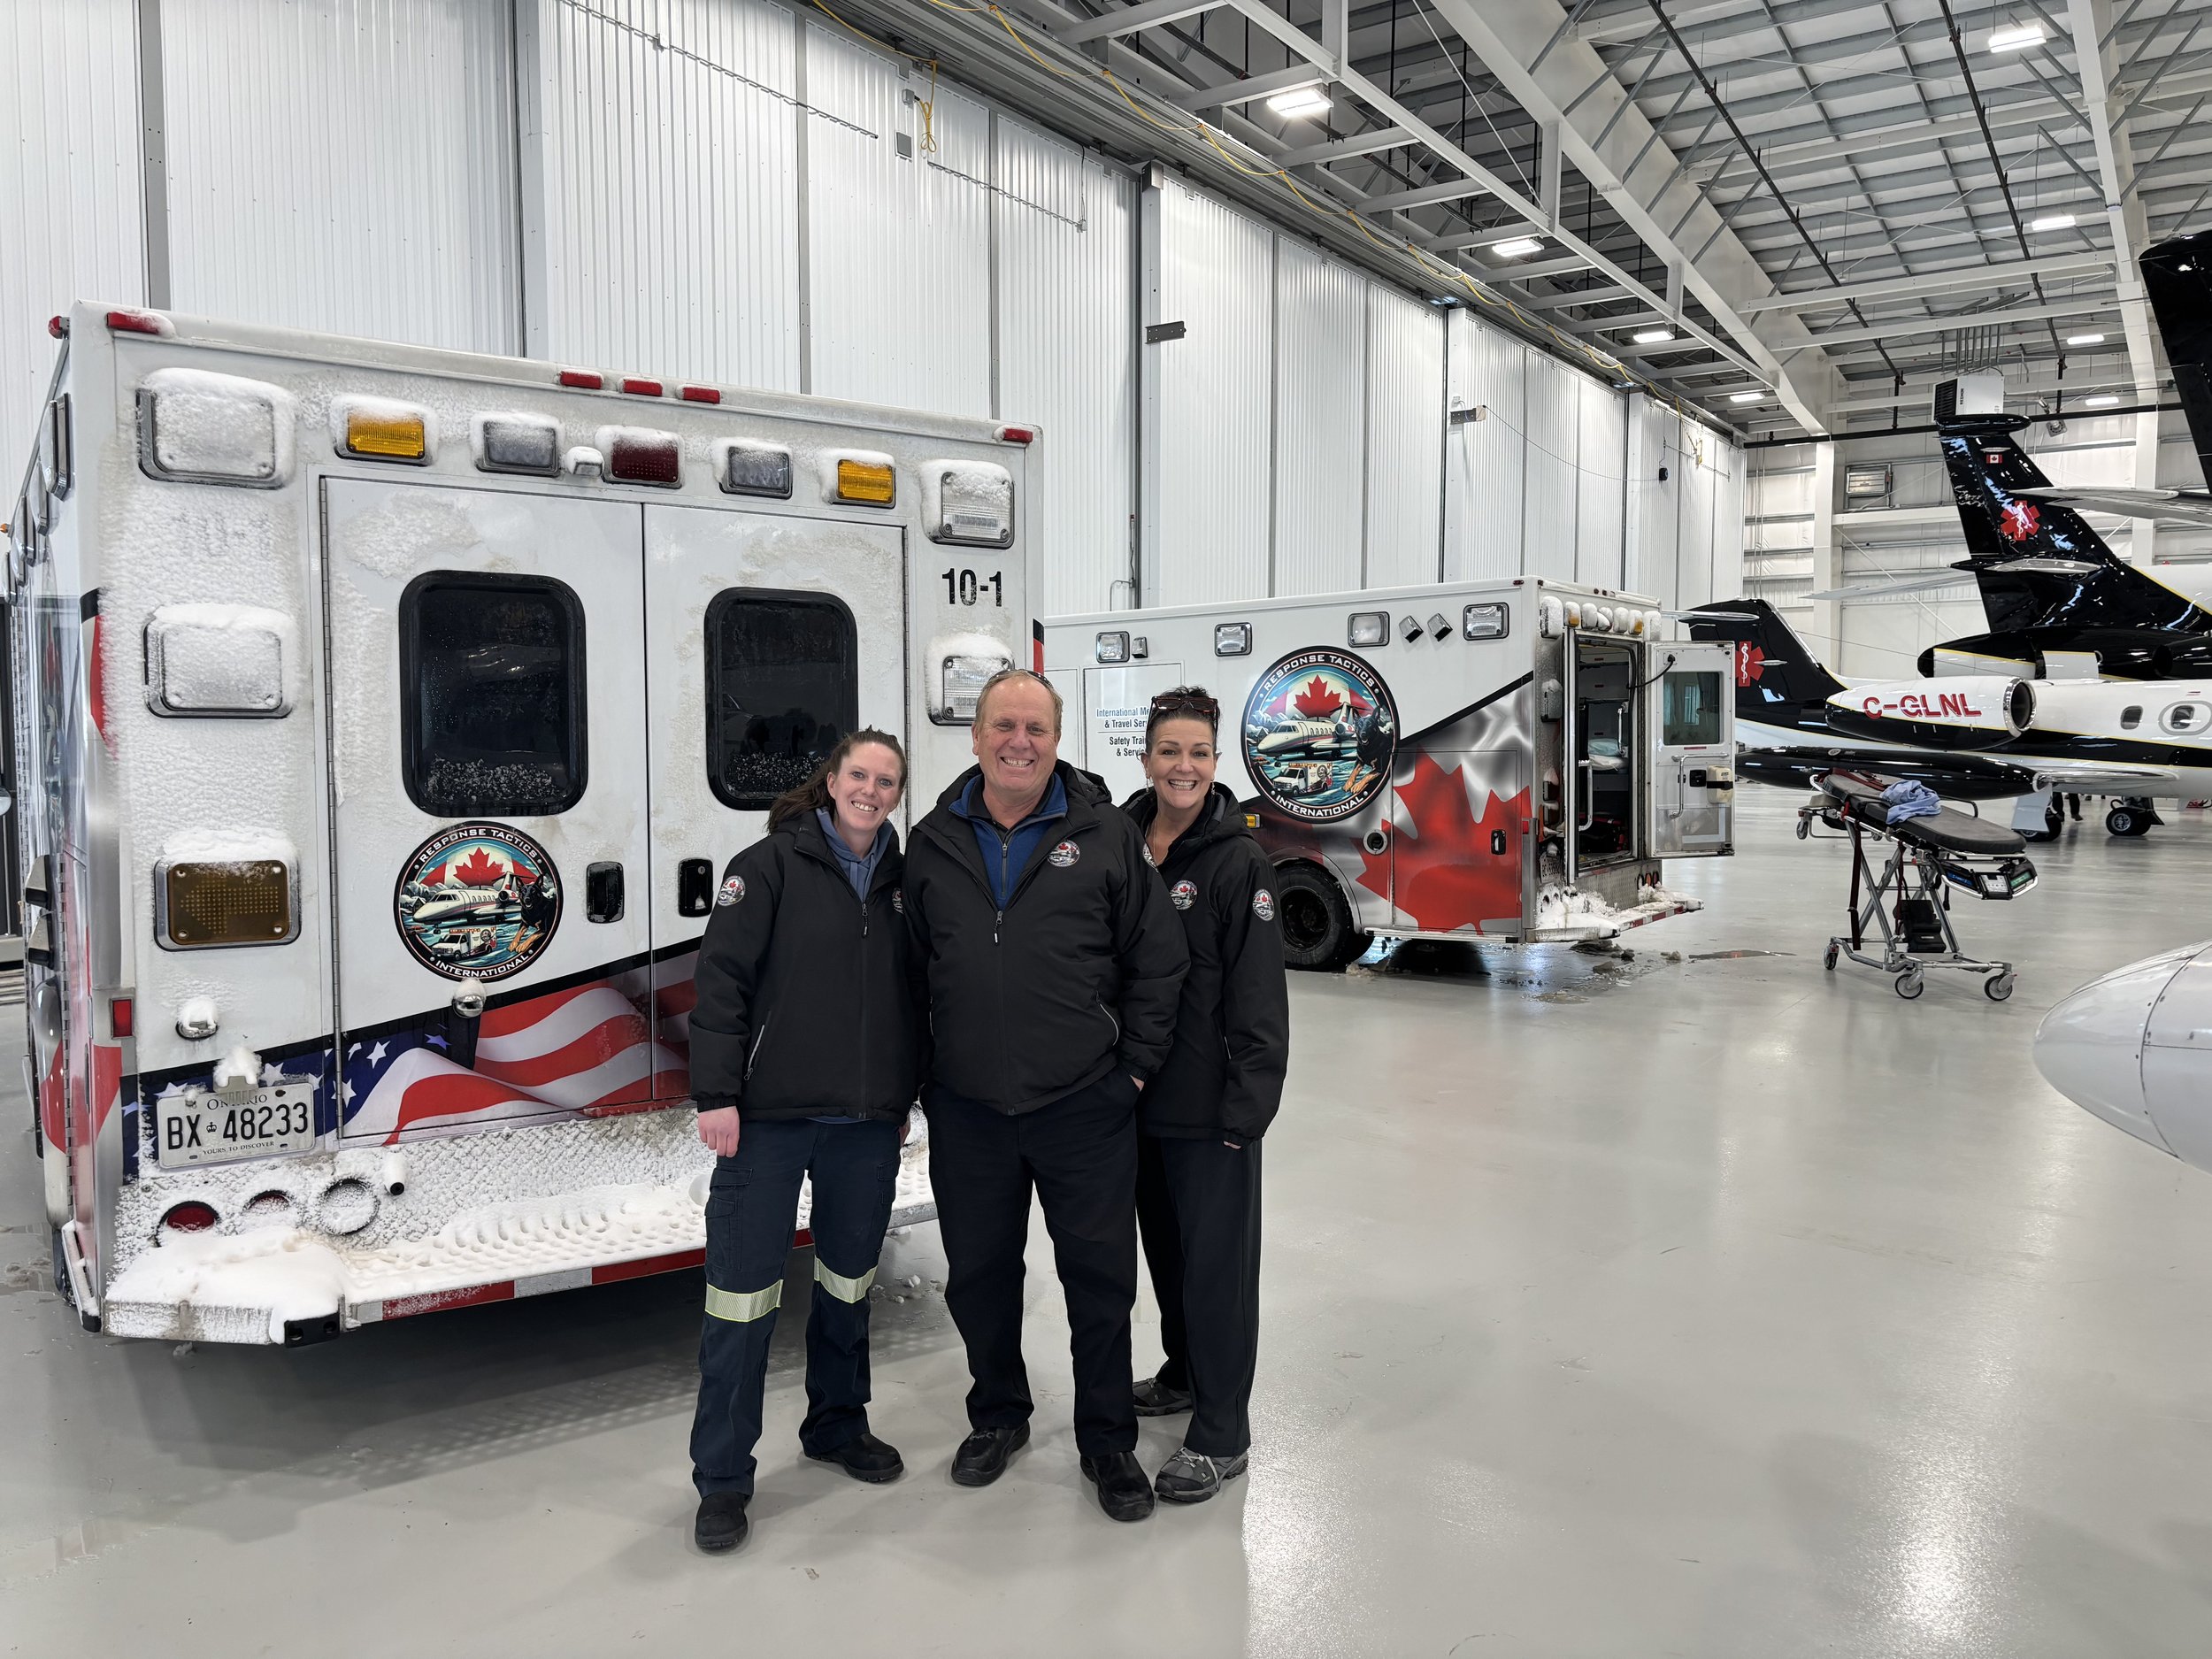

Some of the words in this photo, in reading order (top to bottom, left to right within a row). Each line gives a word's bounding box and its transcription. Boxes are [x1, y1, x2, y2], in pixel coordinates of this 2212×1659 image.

[941, 567, 1002, 607] 10-1
[1263, 654, 1325, 691] RESPONSE
[1329, 655, 1375, 687] TACTICS
[1096, 708, 1139, 718] International
[1862, 693, 1982, 720] C-GLNL
[1104, 719, 1110, 728] &
[1111, 719, 1133, 728] Travel
[1109, 736, 1131, 747] Safety
[1116, 748, 1122, 757] &
[1275, 795, 1364, 817] INTERNATIONAL
[419, 828, 487, 863] RESPONSE
[490, 829, 538, 859] TACTICS
[435, 955, 529, 978] INTERNATIONAL
[206, 1094, 268, 1110] ONIO
[167, 1113, 203, 1150] BX
[222, 1102, 309, 1142] 48233
[240, 1141, 274, 1150] DISCOVER
